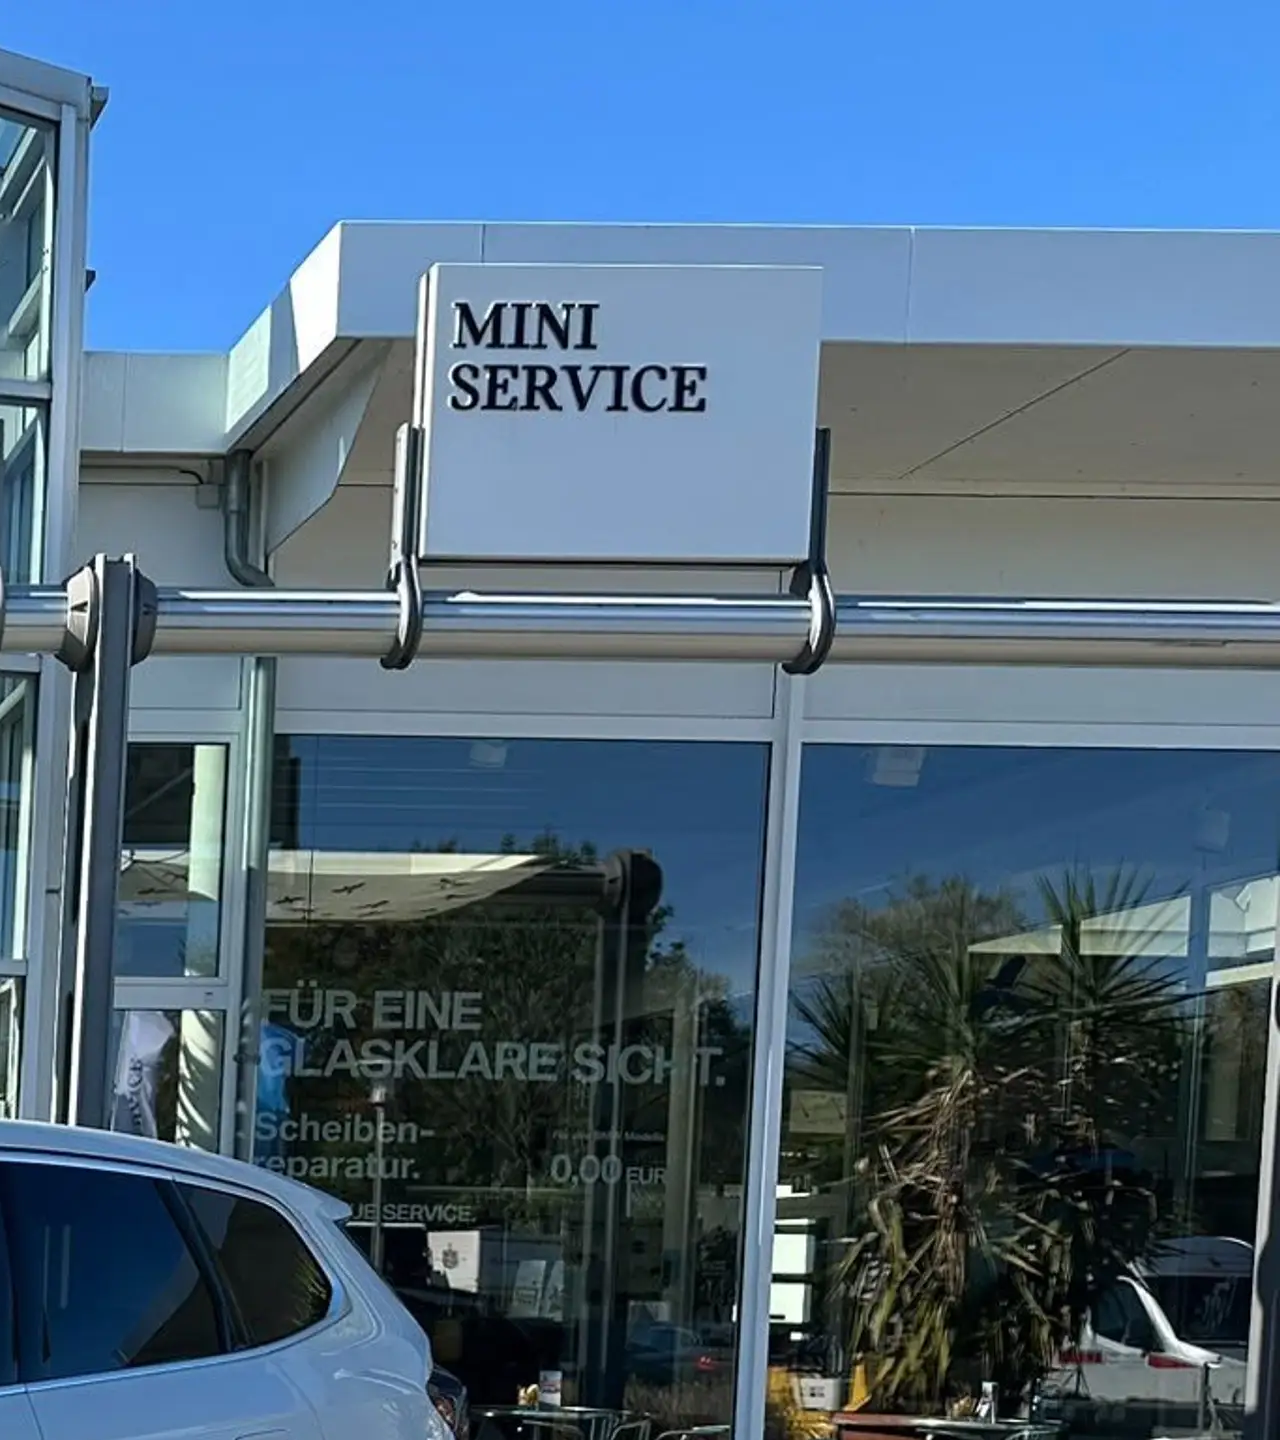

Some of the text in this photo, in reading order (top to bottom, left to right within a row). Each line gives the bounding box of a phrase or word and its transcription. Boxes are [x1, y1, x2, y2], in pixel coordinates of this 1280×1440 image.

[451, 301, 601, 351] MINI
[449, 363, 708, 412] SERVICE
[262, 980, 483, 1031] FÜR EINE
[260, 1036, 726, 1087] GLASKLARE SICHT.
[255, 1111, 435, 1144] Scheiben-
[254, 1153, 421, 1181] reparatur.
[550, 1154, 668, 1187] 0,00 EUR
[382, 1203, 477, 1223] SERVICE.
